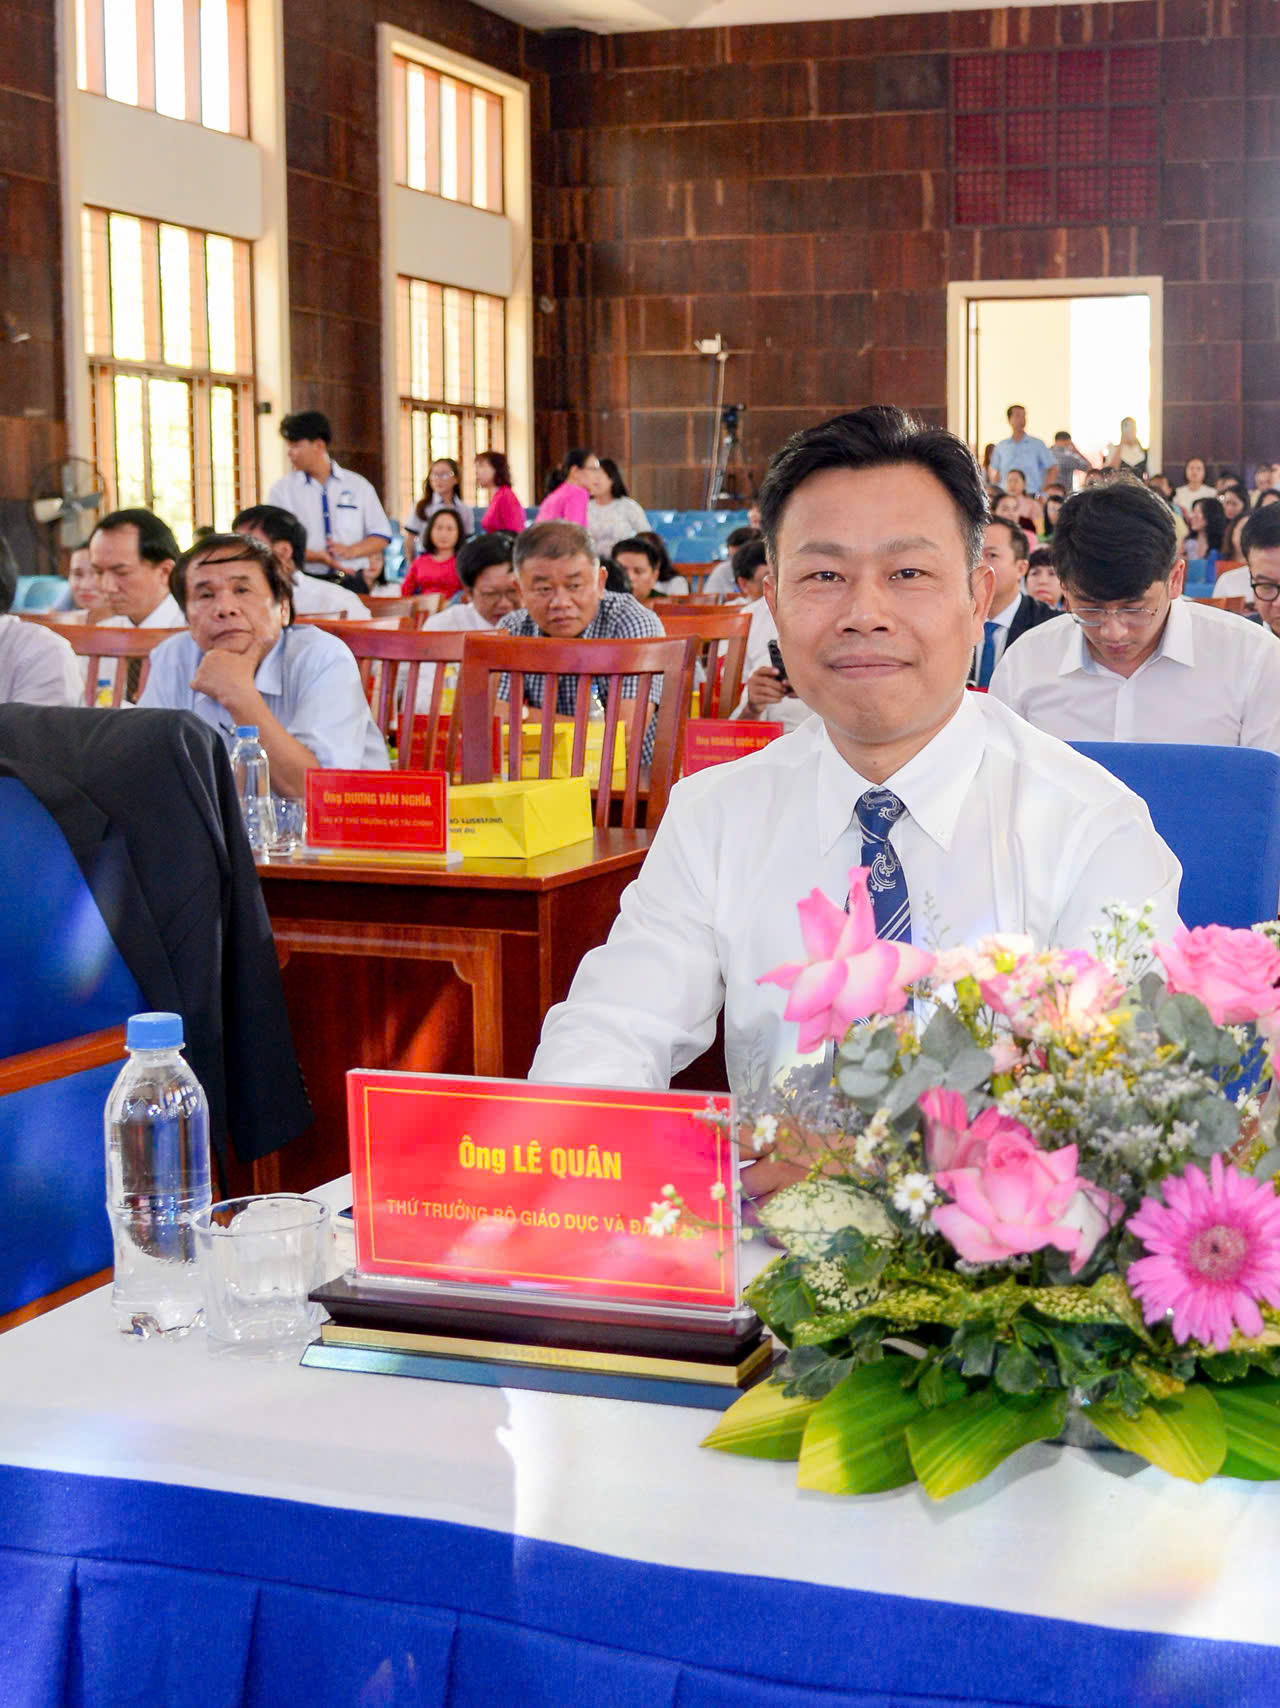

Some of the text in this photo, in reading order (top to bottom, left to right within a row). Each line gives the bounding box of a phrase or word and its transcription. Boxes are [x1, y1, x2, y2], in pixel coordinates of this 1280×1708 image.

[459, 1134, 622, 1180] Ông LÊ QUÂN
[387, 1196, 420, 1217] THỨ
[422, 1198, 489, 1223] TRƯỞNG
[520, 1207, 561, 1229] GIÁO
[564, 1213, 599, 1235] DỤC
[603, 1213, 625, 1233] VÀ
